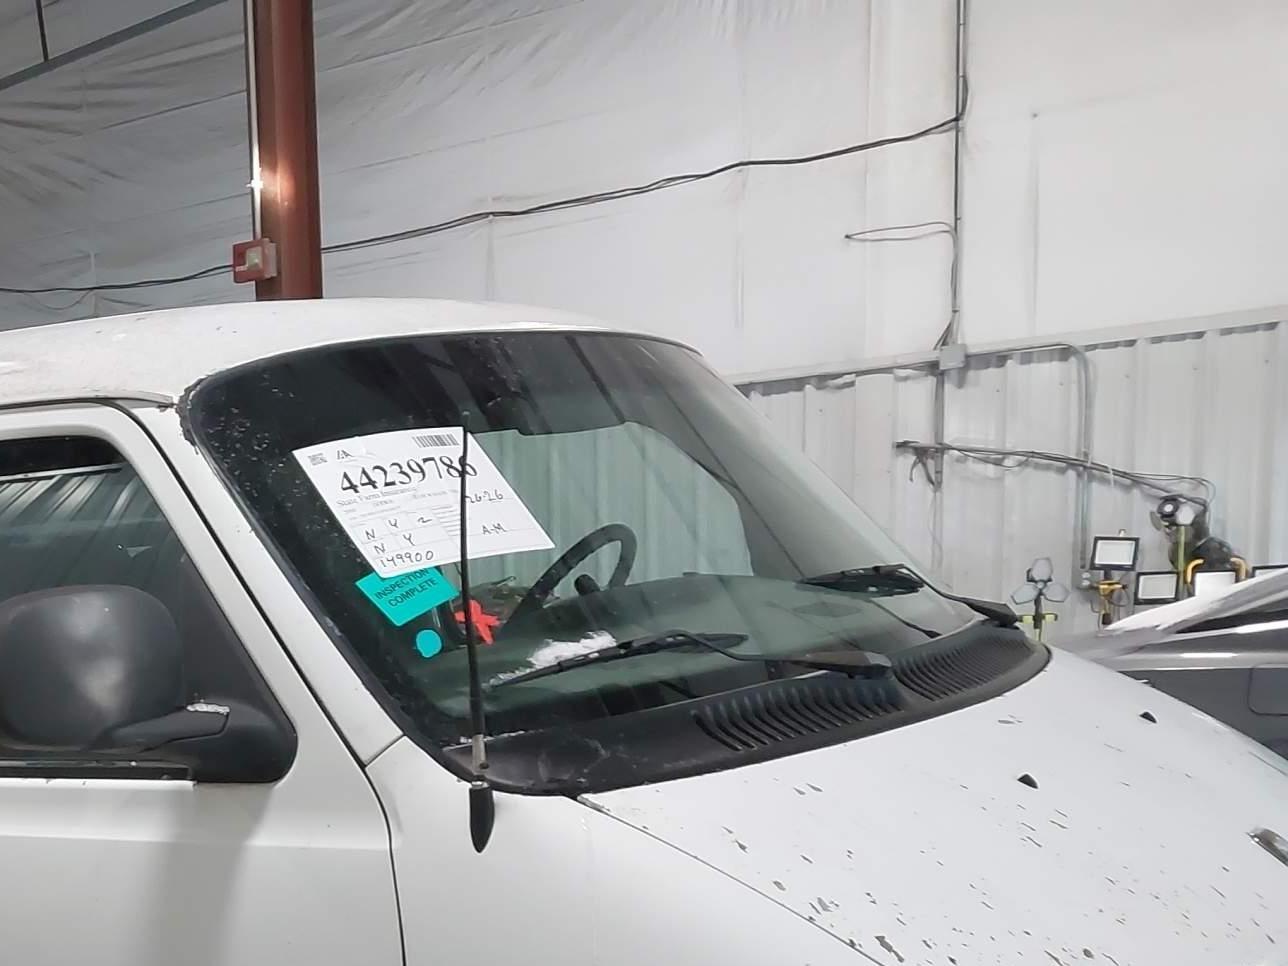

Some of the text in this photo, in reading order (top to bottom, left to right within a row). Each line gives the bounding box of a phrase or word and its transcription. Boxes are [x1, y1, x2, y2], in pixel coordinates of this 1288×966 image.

[341, 455, 478, 493] 44239786
[380, 550, 434, 568] 149900
[374, 567, 430, 600] INSPECTION
[388, 578, 438, 607] COMPLETE
